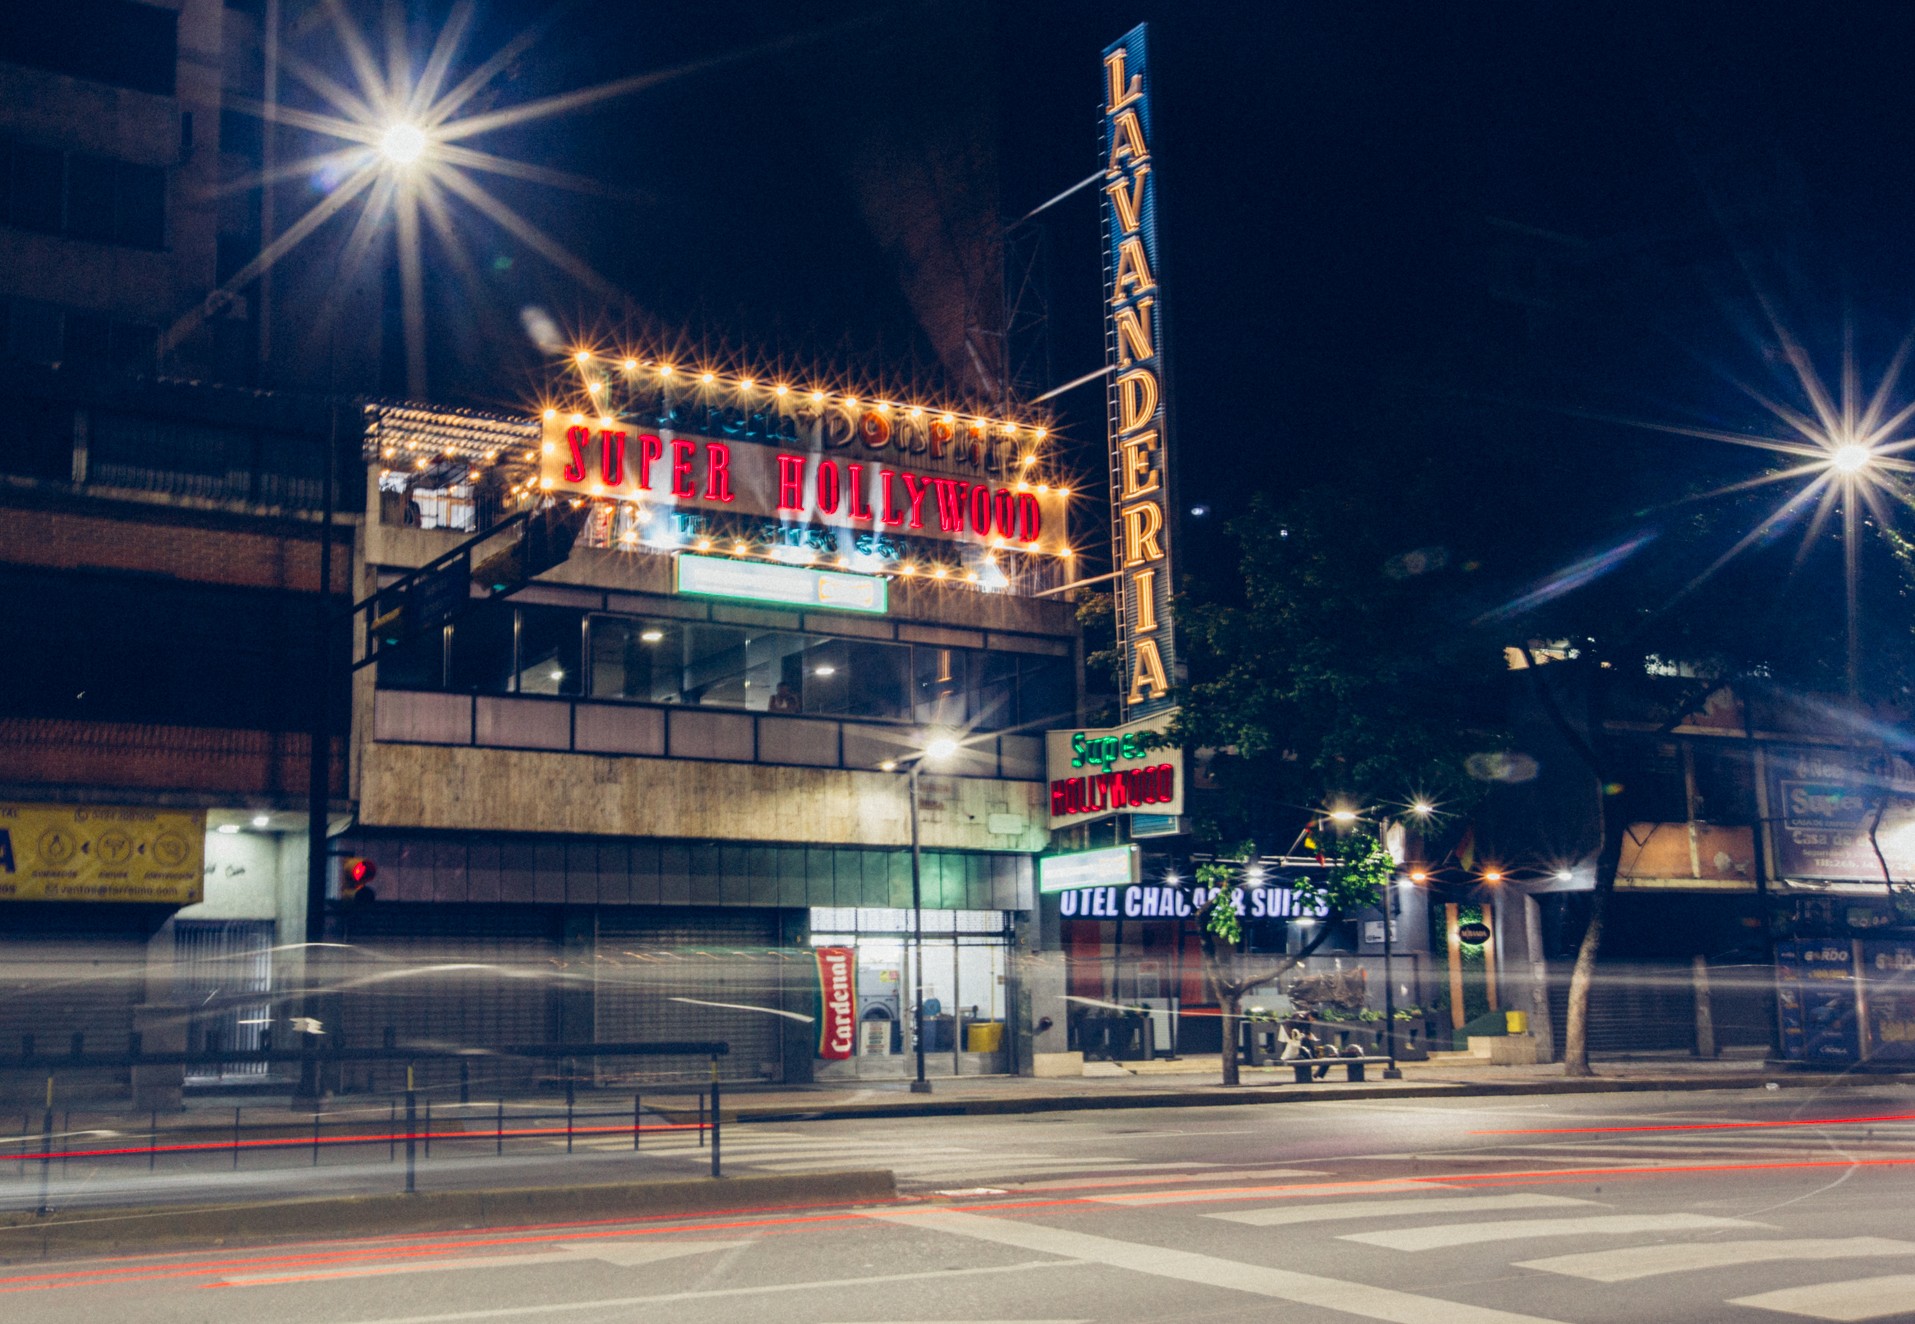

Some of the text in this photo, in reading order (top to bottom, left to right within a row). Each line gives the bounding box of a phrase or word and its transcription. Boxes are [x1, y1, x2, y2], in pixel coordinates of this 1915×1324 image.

[1103, 47, 1168, 705] LAVANDERIA
[564, 424, 734, 502] SUPER
[776, 453, 1041, 542] HOLLYWOOD
[1051, 763, 1174, 816] HOLLYWOOD
[1792, 830, 1827, 845] Casa
[1832, 831, 1852, 847] de
[825, 954, 853, 1053] Cardenal
